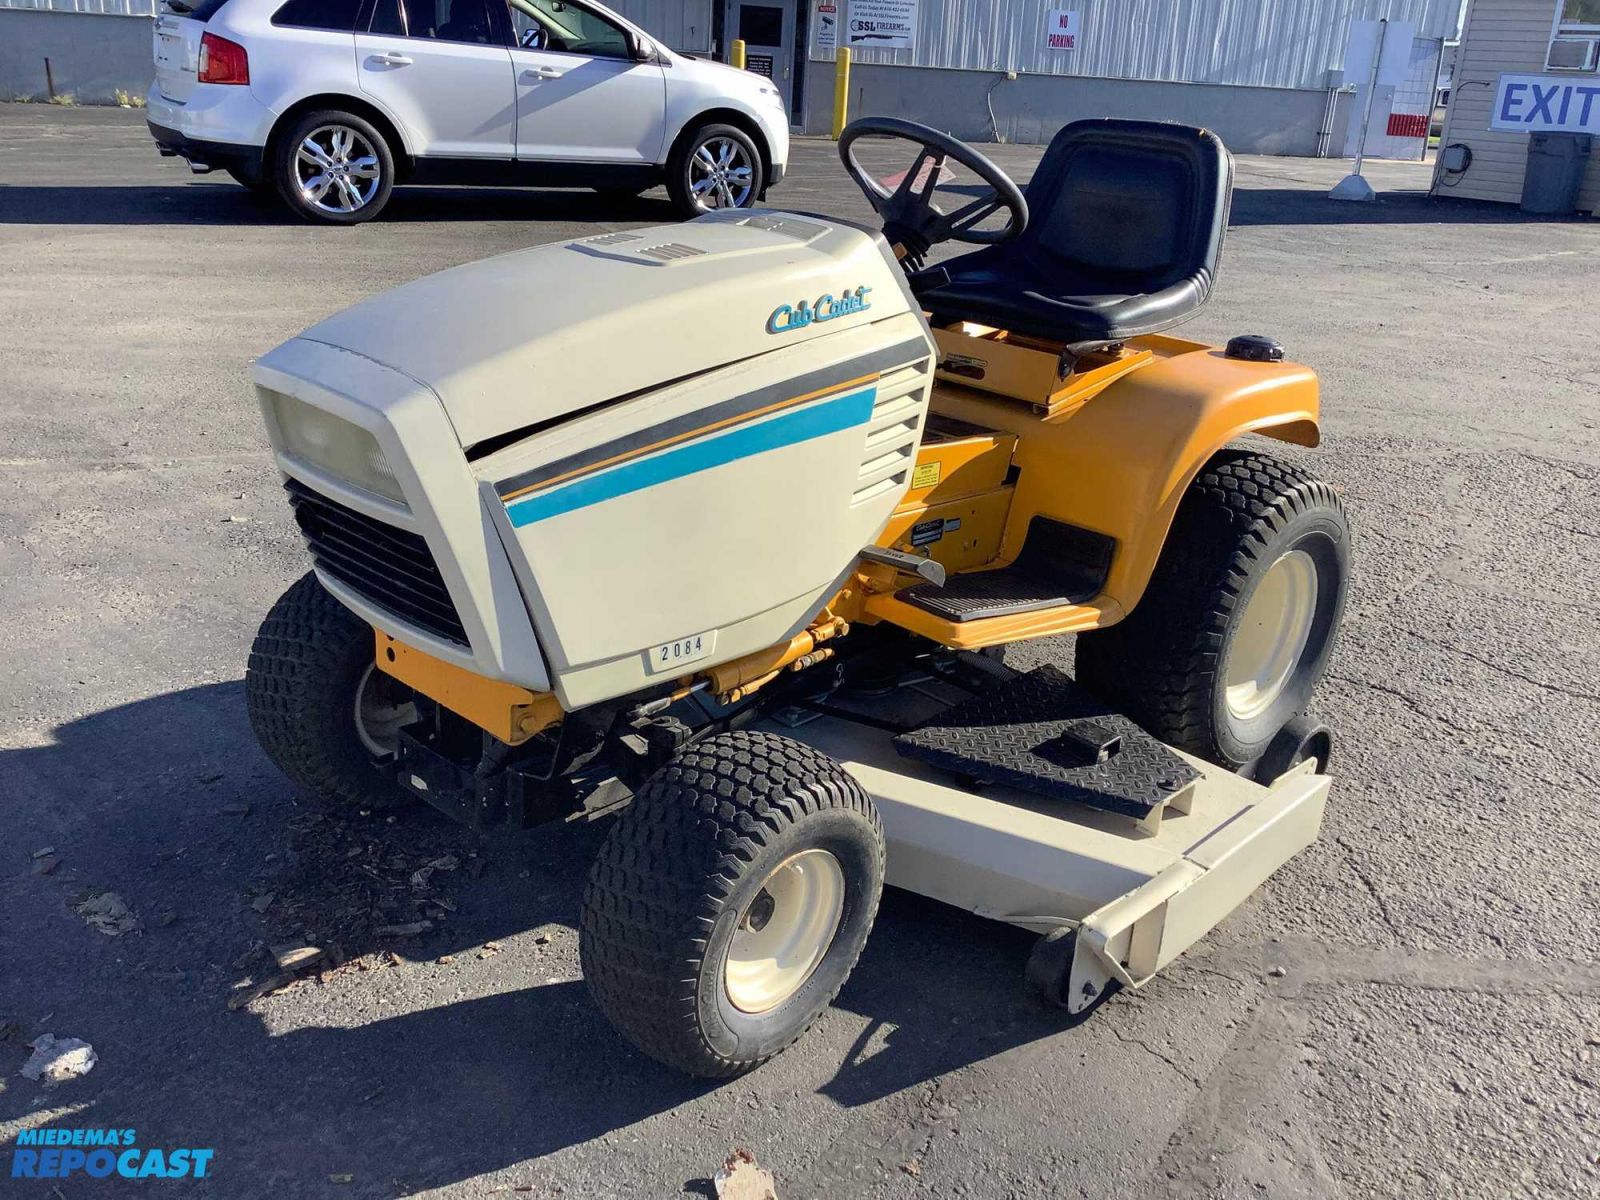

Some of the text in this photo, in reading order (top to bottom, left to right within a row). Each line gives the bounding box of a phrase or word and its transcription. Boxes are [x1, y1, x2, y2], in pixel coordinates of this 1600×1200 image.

[858, 20, 875, 31] SSL
[1059, 14, 1069, 28] NO
[1048, 33, 1075, 48] PARKING
[1500, 83, 1600, 126] EXIT
[765, 285, 873, 335] Cub Cadet
[662, 637, 701, 661] 2084
